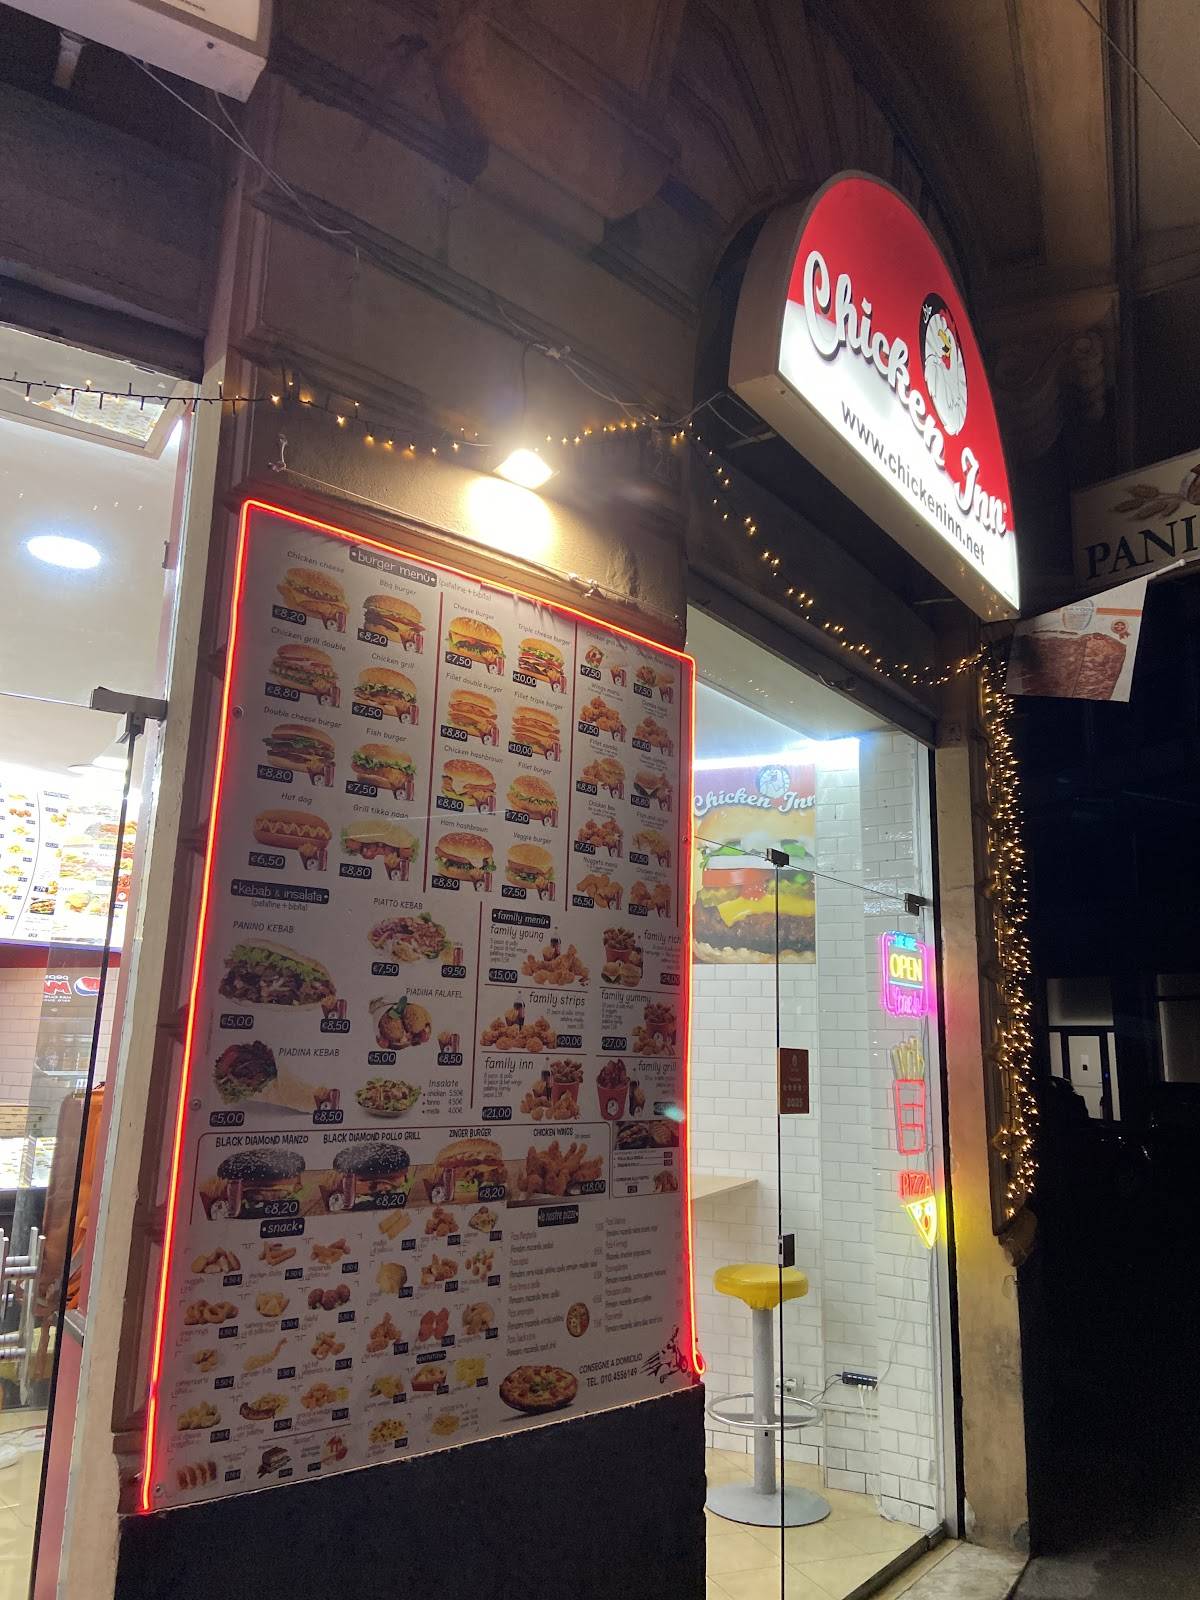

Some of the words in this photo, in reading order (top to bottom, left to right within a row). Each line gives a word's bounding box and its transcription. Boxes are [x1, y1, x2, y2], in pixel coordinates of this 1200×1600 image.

[803, 250, 946, 467] Chicken
[954, 446, 1007, 535] Inn
[841, 400, 986, 567] www.chickeninn.net
[1083, 515, 1199, 581] PANI
[287, 550, 318, 566] Chicken
[319, 559, 345, 574] cheese
[358, 551, 396, 572] burger
[394, 583, 417, 596] burger
[275, 607, 306, 623] €8,20
[453, 602, 474, 614] Cheese
[475, 608, 495, 621] burger
[271, 625, 302, 641] Chicken
[303, 632, 320, 646] grill
[321, 638, 346, 652] double
[359, 630, 387, 646] €8,20
[518, 623, 534, 633] Triple
[534, 628, 553, 639] cheese
[553, 634, 571, 647] burger
[371, 652, 399, 667] Chicken
[400, 658, 415, 670] grill
[446, 654, 472, 667] €7,50
[513, 673, 537, 687] €10,00
[582, 666, 601, 680] €7,50
[267, 684, 299, 701] €8,80
[463, 678, 483, 690] double
[483, 683, 504, 695] burger
[634, 686, 652, 698] €7,50
[530, 695, 546, 707] triple
[546, 700, 564, 712] burger
[263, 706, 290, 719] Double
[290, 712, 316, 724] cheese
[317, 717, 343, 730] burger
[354, 704, 382, 718] €7,50
[366, 727, 382, 738] Fish
[382, 731, 408, 743] burger
[442, 728, 467, 740] €8,80
[579, 723, 599, 736] €7,50
[443, 745, 468, 759] Chicken
[509, 744, 533, 757] €10,00
[260, 767, 292, 782] €8,80
[533, 765, 553, 777] burger
[347, 783, 378, 796] €7,50
[577, 781, 597, 794] €8,80
[298, 795, 313, 806] dog
[438, 799, 463, 811] €8,80
[695, 787, 772, 817] Chicken
[353, 804, 370, 813] Grill
[440, 819, 457, 829] Ham
[506, 812, 529, 824] €7,50
[533, 835, 552, 846] burger
[575, 842, 595, 854] €7,50
[250, 854, 285, 868] €6,50
[341, 865, 372, 878] €8,80
[433, 877, 459, 890] €8,80
[238, 881, 272, 898] kebab
[283, 889, 323, 902] insalata
[503, 886, 526, 898] €7,50
[373, 897, 399, 908] PIATTO
[399, 900, 424, 910] KEBAB
[573, 895, 594, 908] €6,50
[497, 910, 524, 925] family
[232, 920, 265, 932] PANINO
[266, 923, 295, 934] KEBAB
[490, 924, 518, 940] family
[519, 930, 545, 943] young
[644, 929, 667, 945] family
[372, 963, 399, 975] €7,50
[442, 965, 466, 978] €9,50
[889, 953, 923, 981] OPEN
[490, 969, 518, 982] €15,00
[406, 987, 433, 997] PIADINA
[434, 989, 463, 999] FALAFEL
[529, 991, 559, 1008] family
[559, 992, 586, 1008] strips
[601, 989, 624, 1004] family
[221, 1015, 254, 1028] €5,00
[321, 1019, 350, 1032] €8,50
[278, 1047, 312, 1057] PIADINA
[313, 1047, 340, 1057] KEBAB
[369, 1053, 396, 1064] €5,00
[438, 1053, 463, 1064] €8,50
[485, 1056, 516, 1073] family
[518, 1060, 534, 1070] inn
[638, 1060, 662, 1075] family
[662, 1062, 678, 1075] grill
[429, 1079, 460, 1089] Insalate
[211, 1112, 245, 1126] €5,00
[314, 1111, 343, 1123] €8,50
[323, 1132, 347, 1144] BLACK
[348, 1131, 380, 1142] DIAMOND
[381, 1131, 403, 1141] POLLO
[404, 1131, 421, 1140] GRILL
[449, 1129, 469, 1138] ZINGER
[469, 1128, 492, 1137] BURGER
[533, 1128, 556, 1137] CHICKEN
[557, 1127, 574, 1136] WINGS
[215, 1136, 245, 1148] BLACK
[245, 1135, 281, 1146] DIAMOND
[281, 1134, 309, 1146] MANZO
[902, 1172, 933, 1198] PIZZA
[479, 1186, 505, 1199] €8,20
[376, 1194, 405, 1207] €8,20
[264, 1201, 298, 1215] €8,20
[267, 1220, 299, 1235] snack
[579, 1359, 611, 1375] CONSEGNE
[615, 1353, 643, 1367] DOMICILIO
[587, 1377, 599, 1388] TEL.
